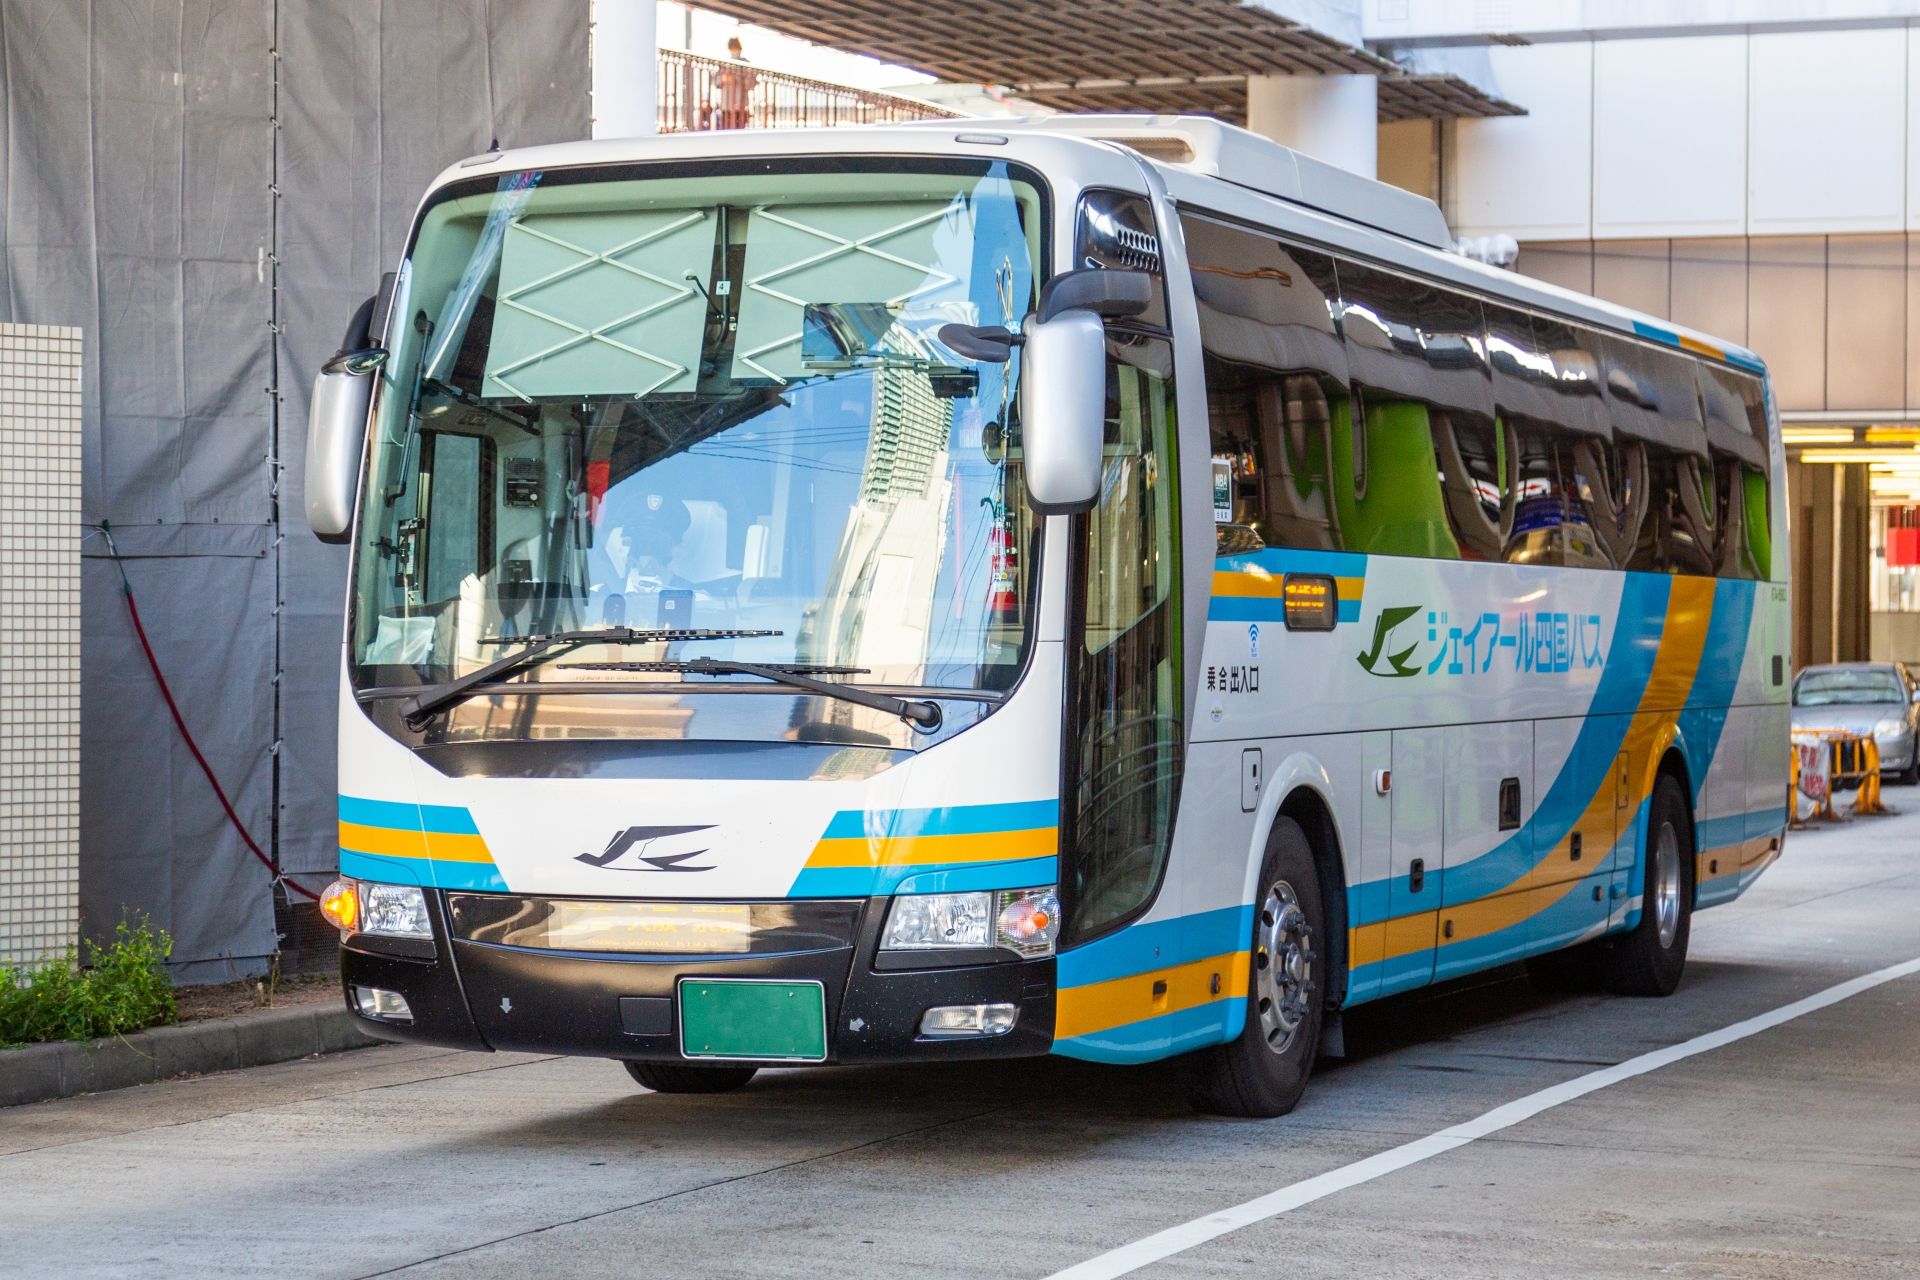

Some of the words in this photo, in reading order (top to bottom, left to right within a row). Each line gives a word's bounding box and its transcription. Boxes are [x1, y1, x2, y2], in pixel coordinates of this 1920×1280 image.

[1215, 473, 1228, 489] NBA
[1427, 611, 1604, 676] ジェイアール四国バス
